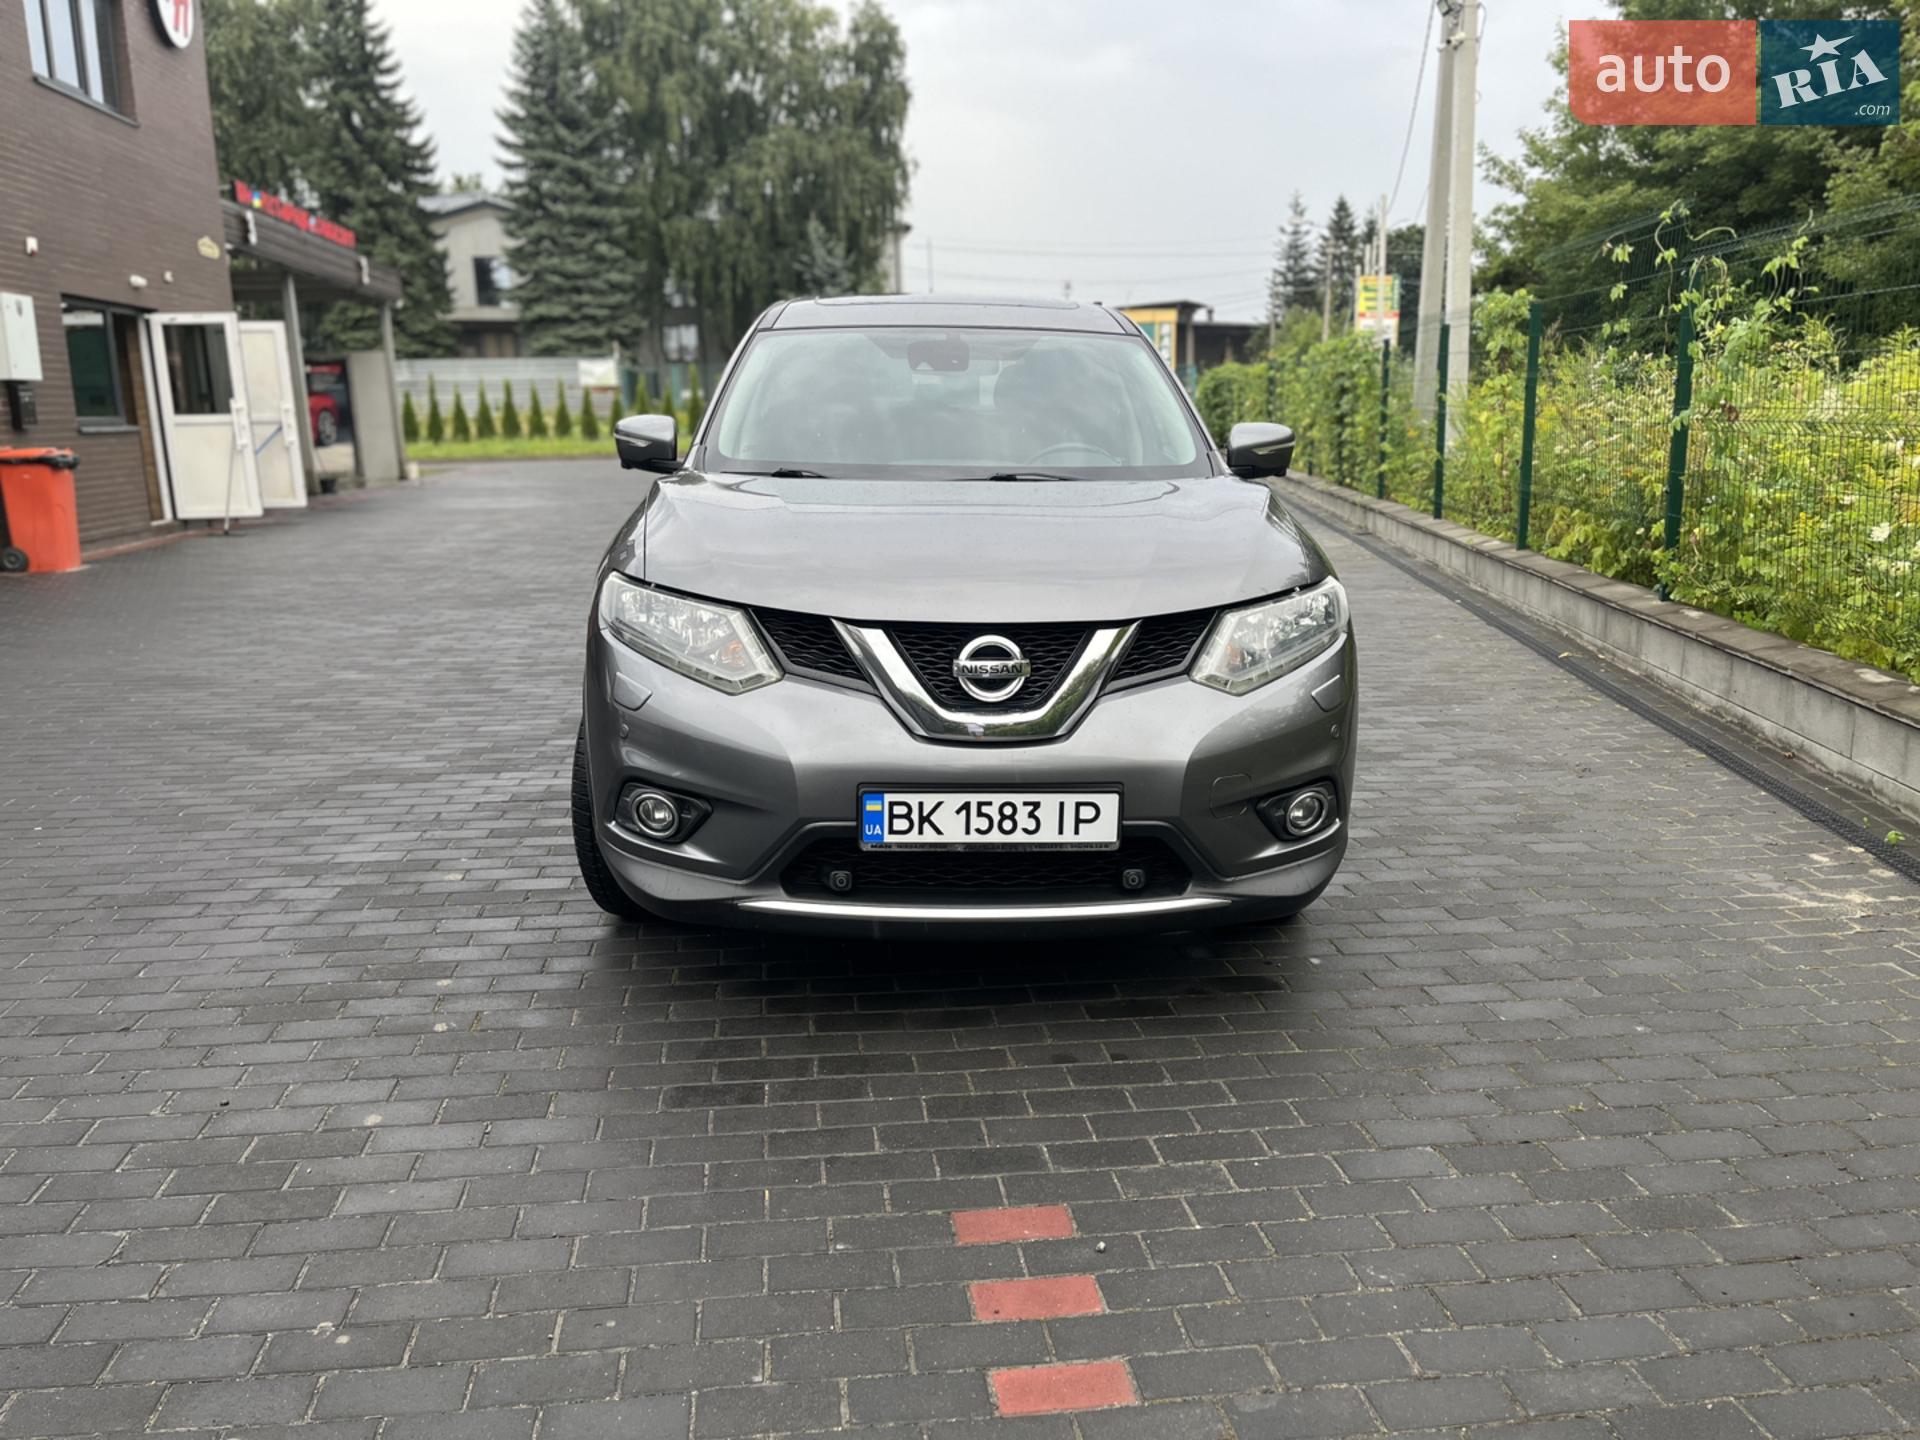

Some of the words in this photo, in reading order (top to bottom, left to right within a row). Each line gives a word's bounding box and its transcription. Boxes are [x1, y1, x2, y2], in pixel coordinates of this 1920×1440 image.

[961, 664, 1023, 675] NISSAN
[887, 800, 945, 836] BK
[954, 800, 1042, 836] 1583
[1057, 800, 1102, 836] IP
[865, 824, 883, 836] UA
